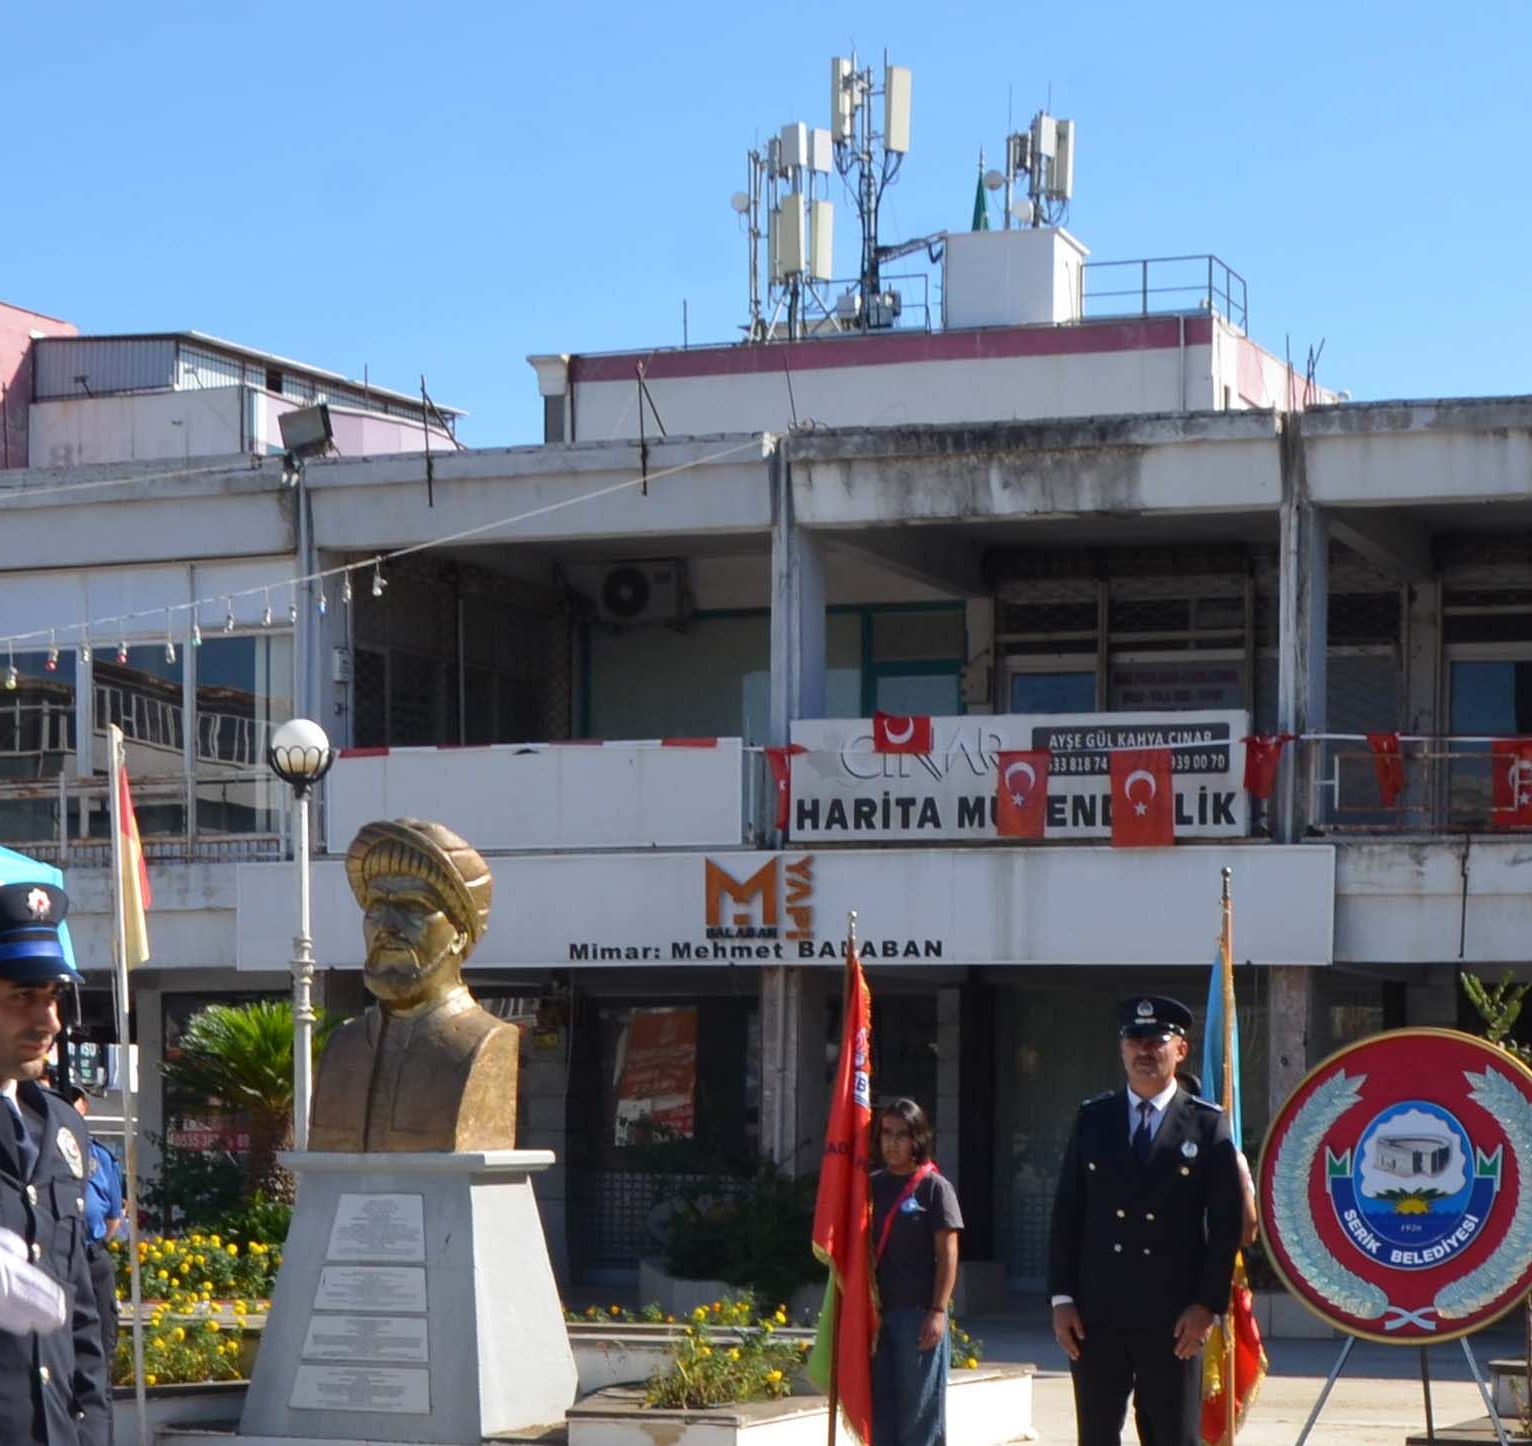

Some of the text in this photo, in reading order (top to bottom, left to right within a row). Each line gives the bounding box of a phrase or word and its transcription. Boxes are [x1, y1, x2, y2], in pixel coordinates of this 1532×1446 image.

[1050, 733, 1082, 752] AYŞE
[1085, 729, 1113, 748] GÜL
[1119, 732, 1164, 748] KAHYA
[1193, 754, 1207, 769] 00
[1211, 754, 1225, 769] 70
[796, 790, 942, 831] HARİTA
[570, 942, 661, 961] Mimar:
[671, 940, 783, 960] Mehmet
[1343, 1208, 1480, 1265] SERİK BELEDİYESİ
